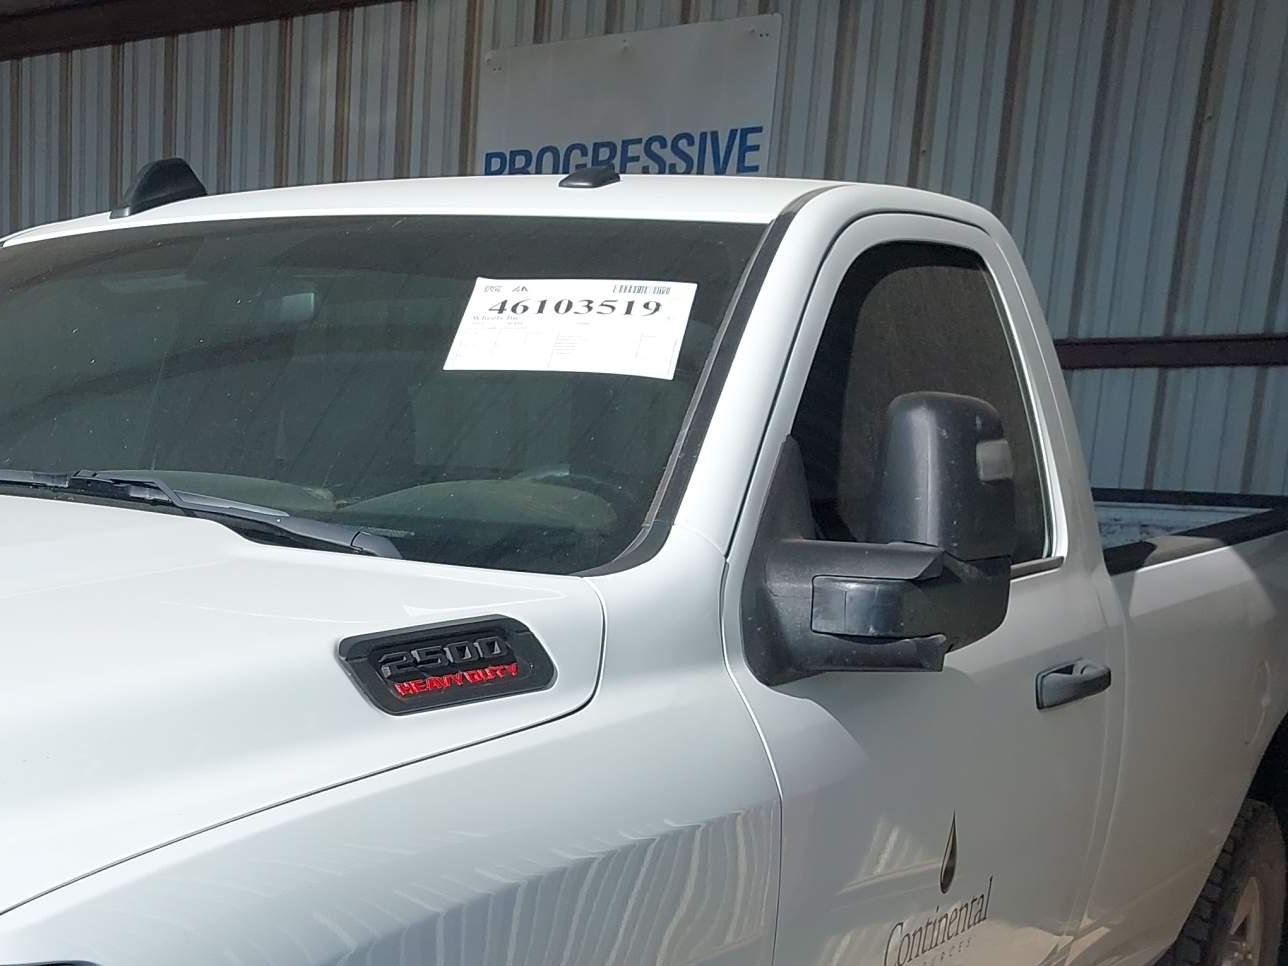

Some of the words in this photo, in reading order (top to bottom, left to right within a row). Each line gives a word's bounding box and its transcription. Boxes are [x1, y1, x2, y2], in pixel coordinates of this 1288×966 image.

[484, 126, 764, 175] PROGRESSIVE
[488, 298, 663, 317] 46103519
[378, 636, 509, 680] 2500
[395, 671, 463, 696] HEAVY
[465, 663, 518, 685] DUTY
